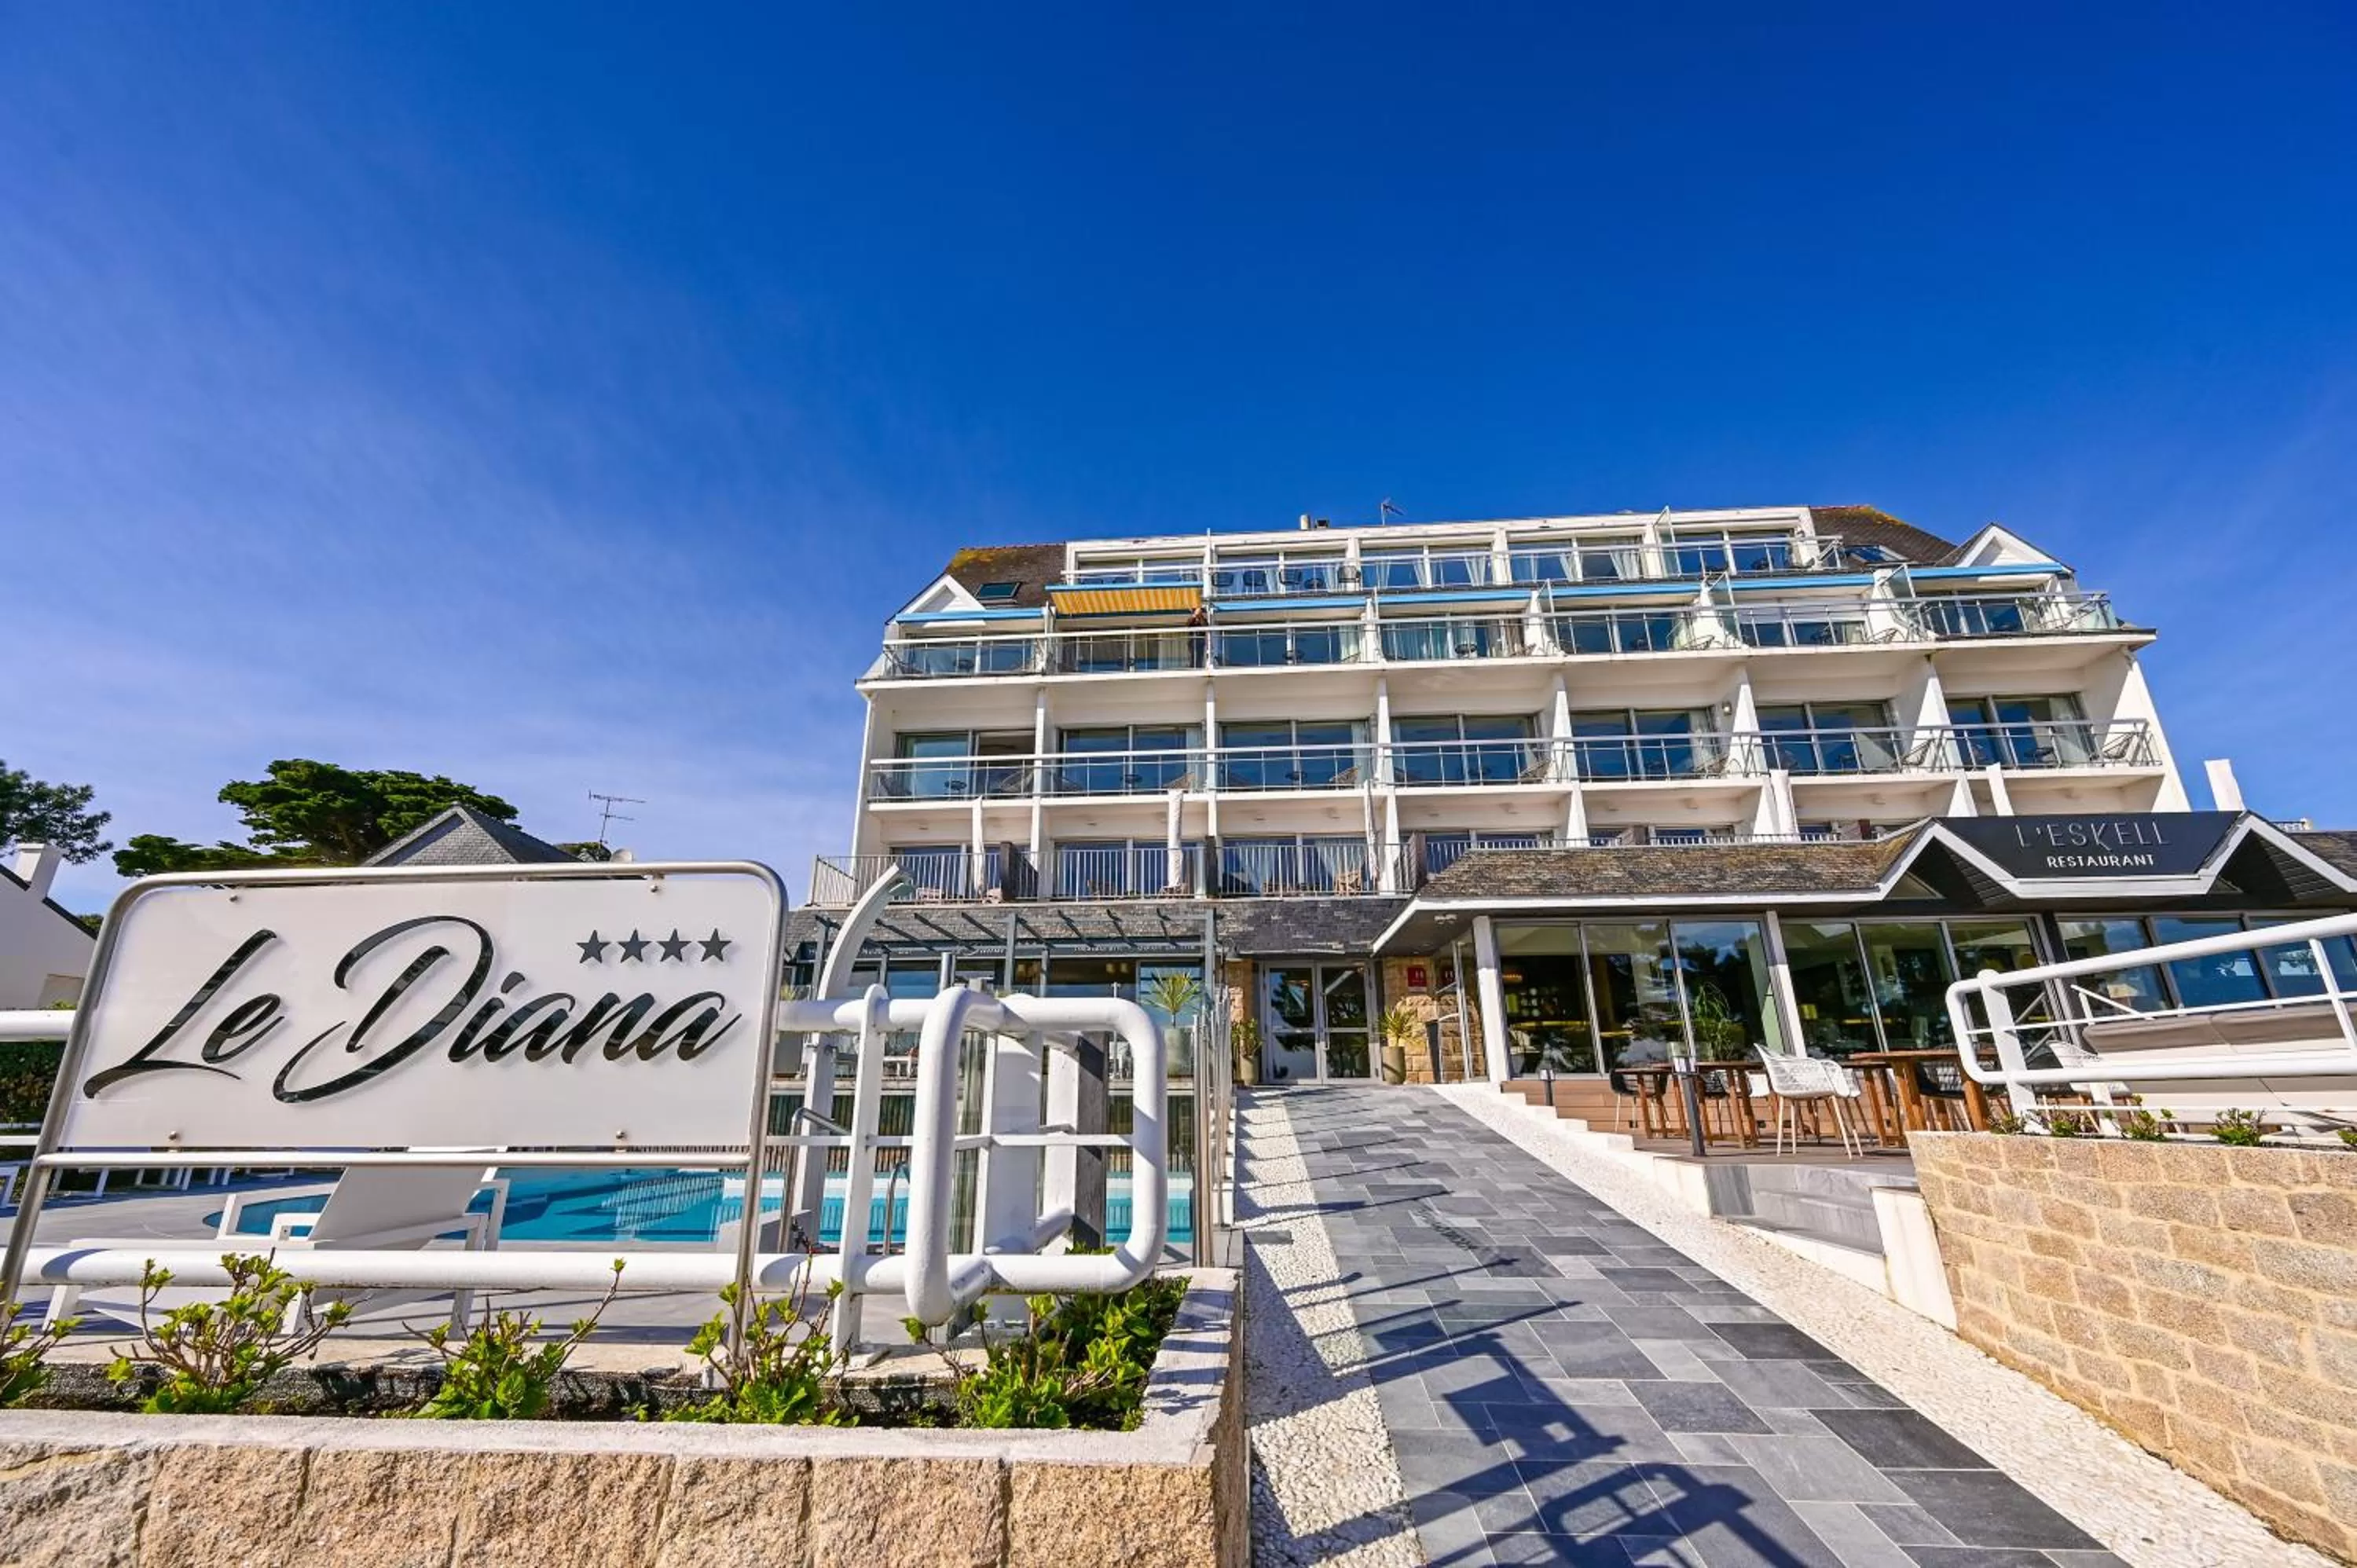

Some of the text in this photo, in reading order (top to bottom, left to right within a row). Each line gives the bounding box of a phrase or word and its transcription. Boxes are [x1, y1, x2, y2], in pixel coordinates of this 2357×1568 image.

[2014, 820, 2171, 852] L'ESKELL
[2046, 854, 2154, 868] RESTAURANT
[83, 915, 742, 1103] Le Diana
